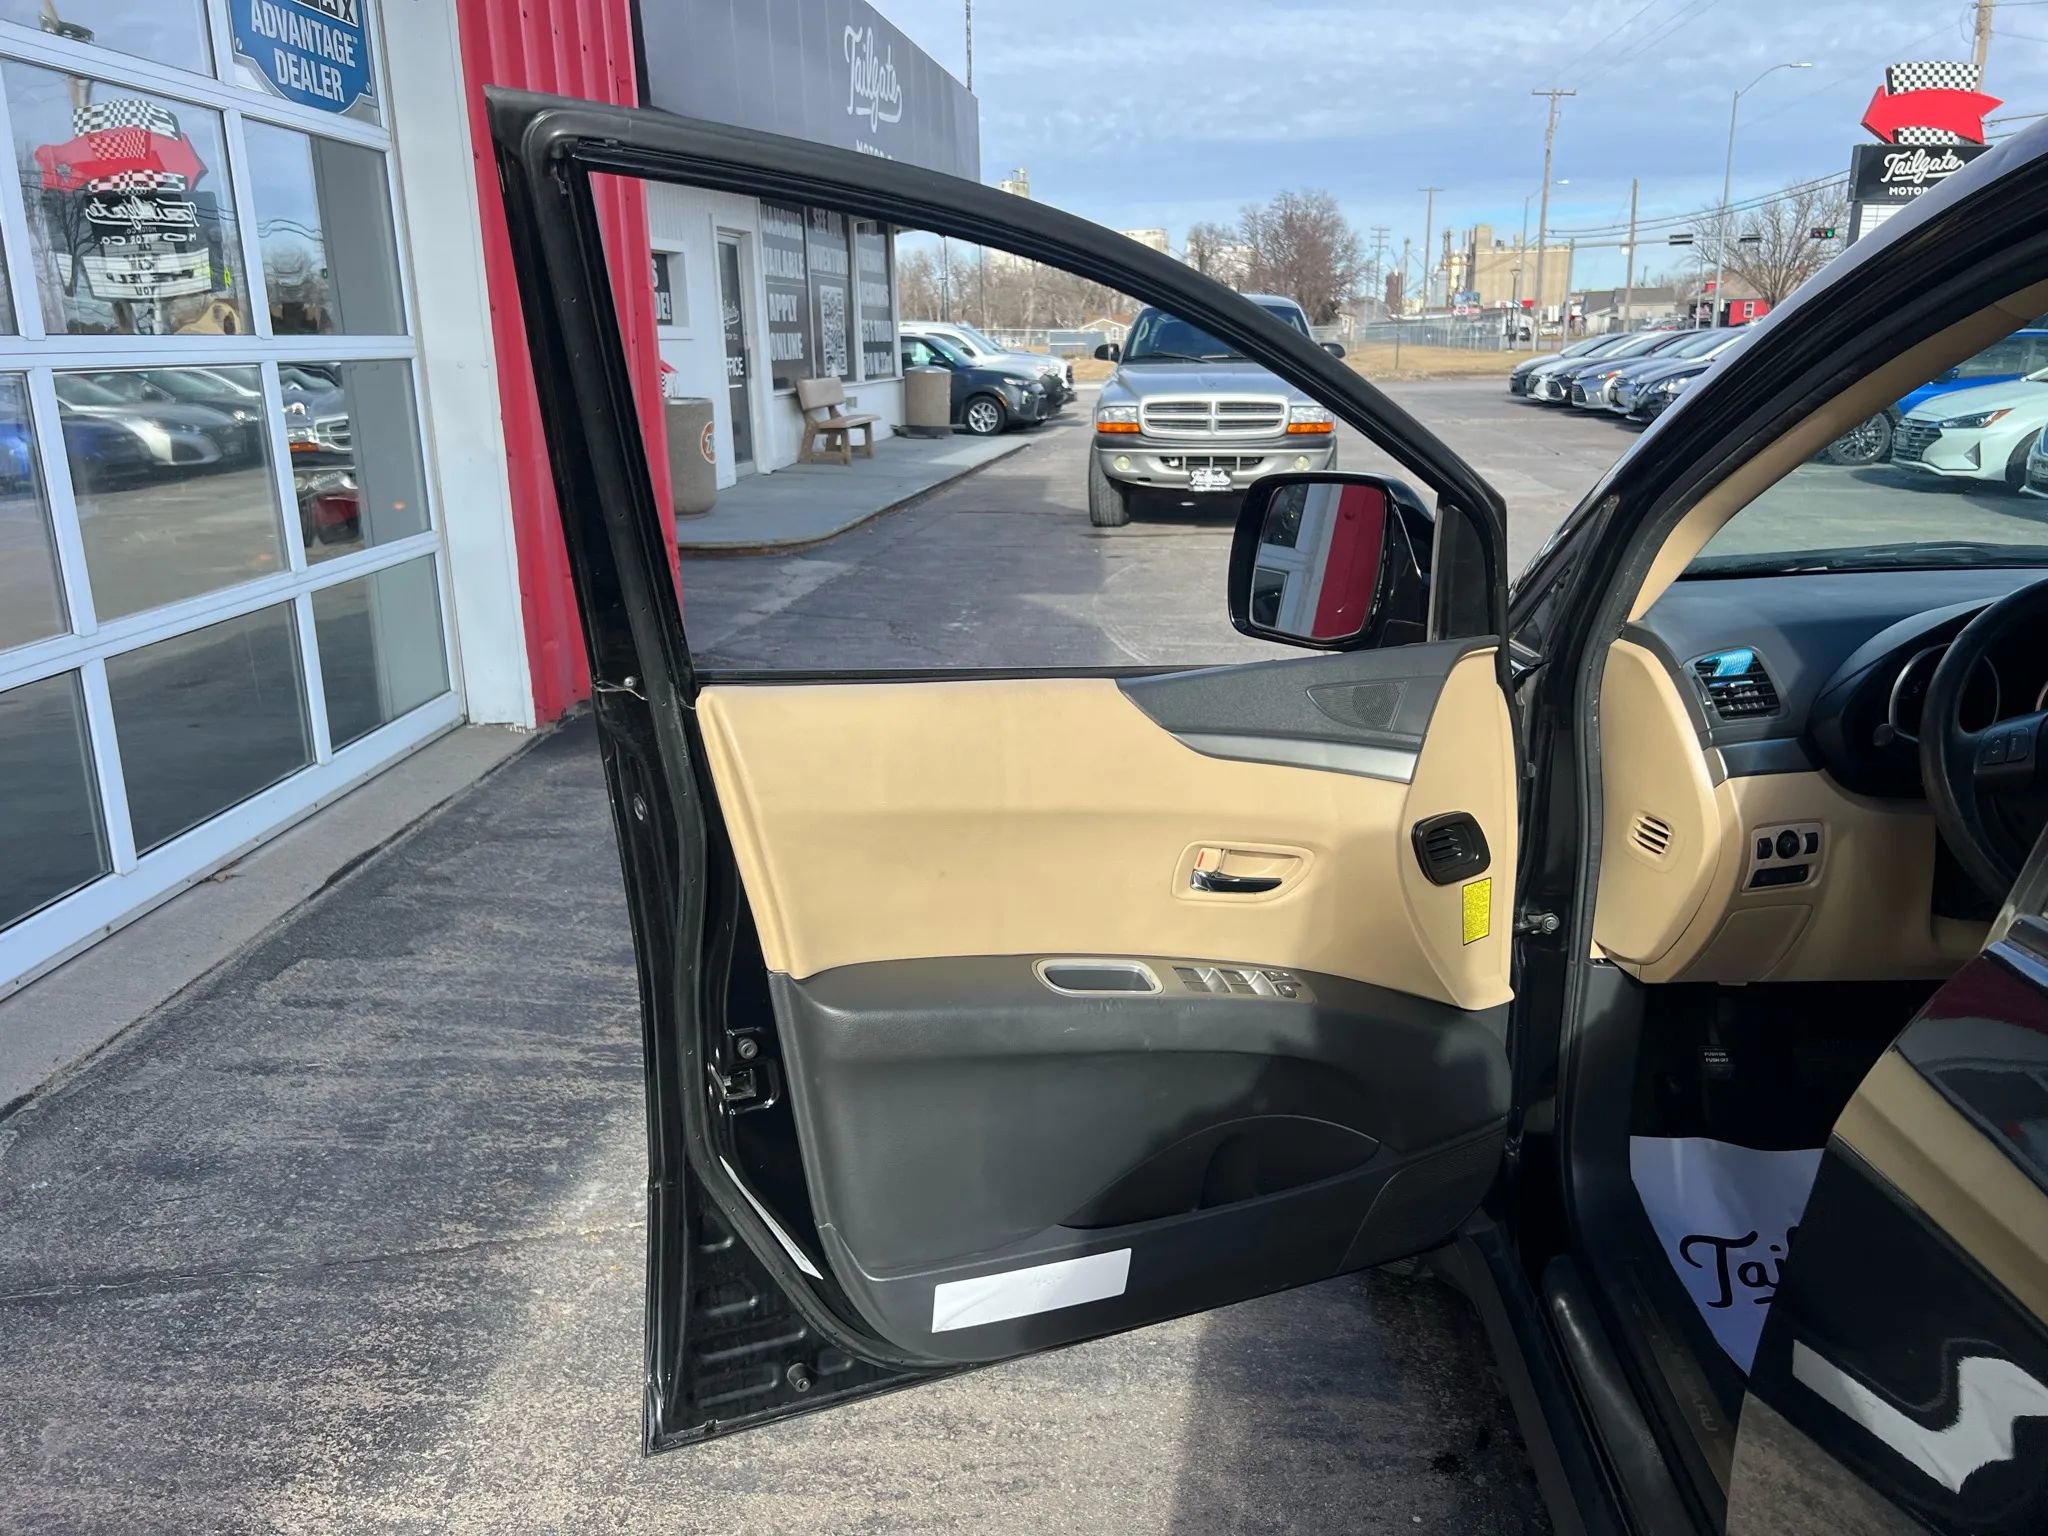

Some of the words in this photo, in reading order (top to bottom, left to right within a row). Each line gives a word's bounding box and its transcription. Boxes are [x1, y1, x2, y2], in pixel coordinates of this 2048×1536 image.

[251, 0, 356, 68] ADVANTAGE
[273, 47, 345, 103] DEALER
[844, 25, 902, 133] Tailgate
[1880, 148, 1965, 184] Tailgate
[769, 293, 797, 322] APPLY
